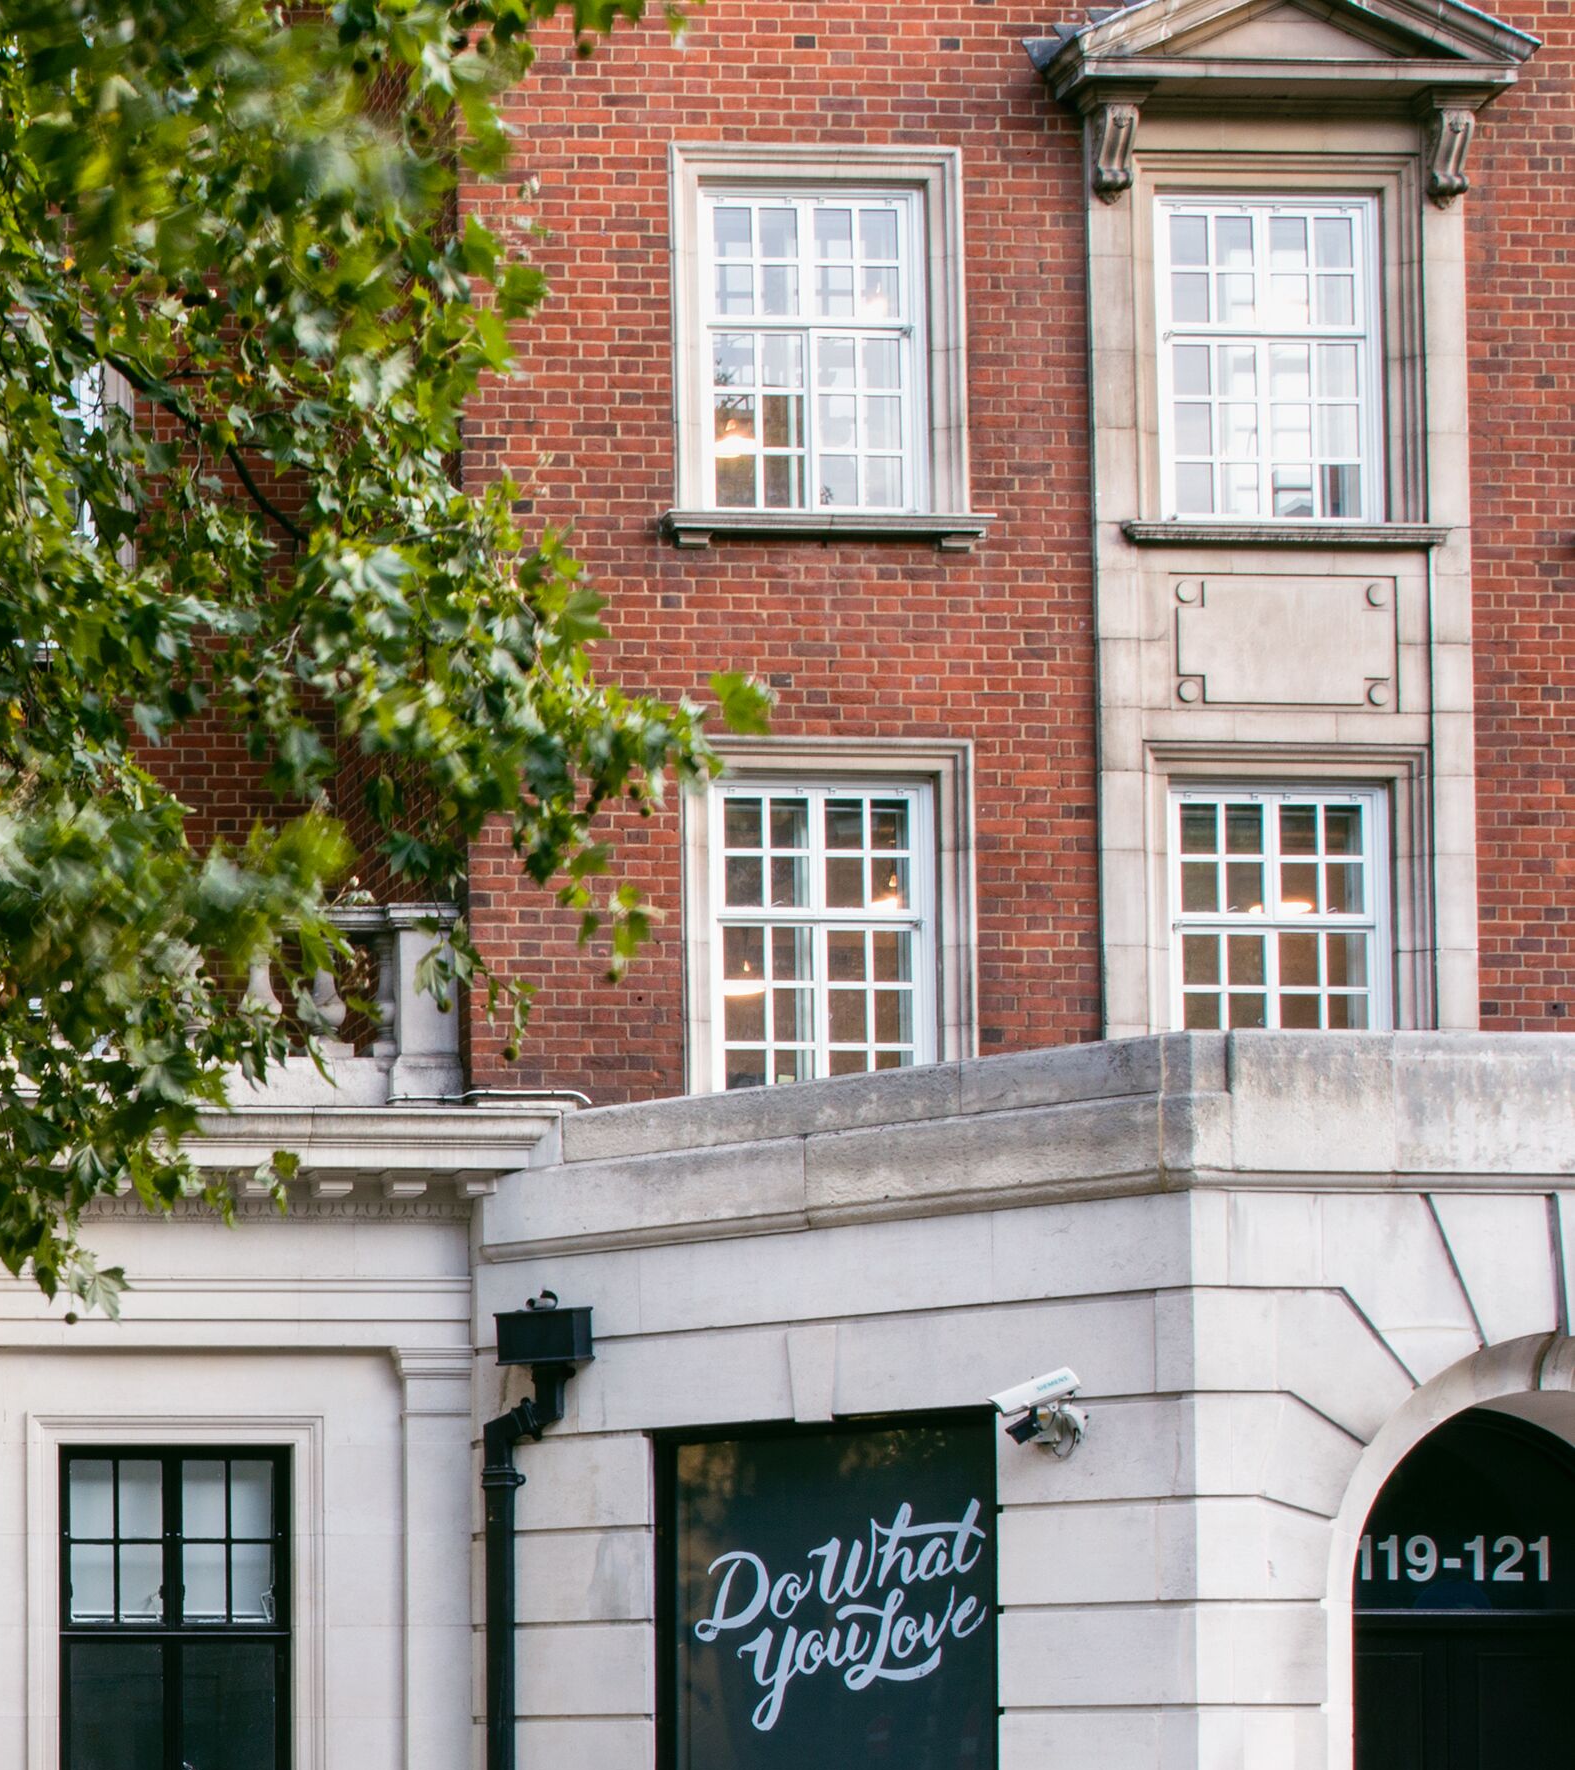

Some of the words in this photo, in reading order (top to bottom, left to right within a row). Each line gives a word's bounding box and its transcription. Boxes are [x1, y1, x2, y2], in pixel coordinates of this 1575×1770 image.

[694, 1550, 813, 1642] Do
[807, 1497, 986, 1604] What
[1357, 1534, 1550, 1582] 119-121
[737, 1624, 870, 1731] You
[835, 1587, 987, 1691] Love
